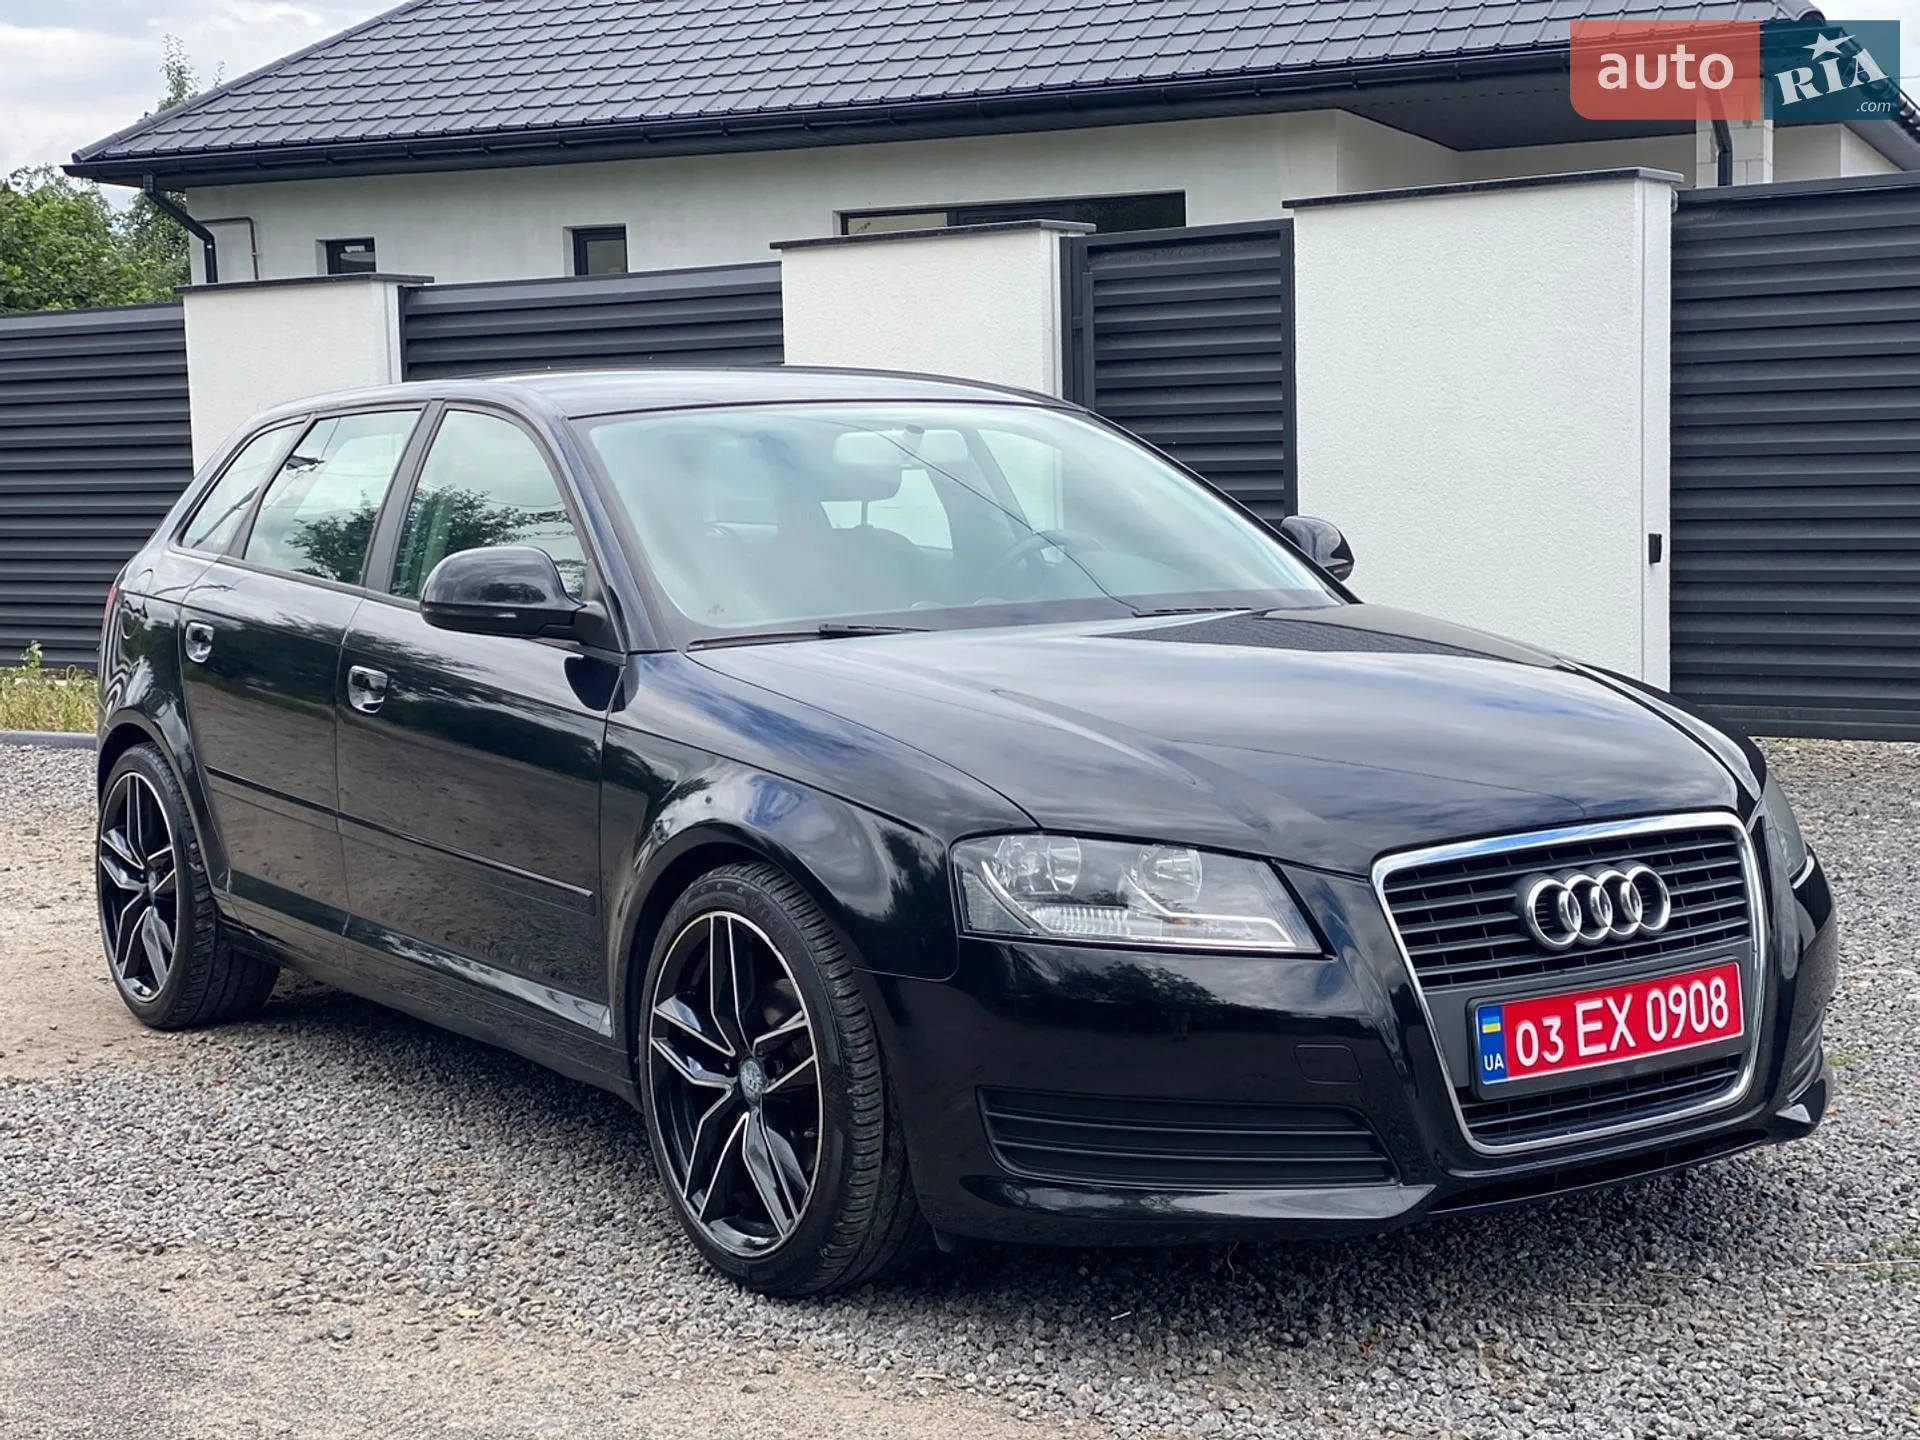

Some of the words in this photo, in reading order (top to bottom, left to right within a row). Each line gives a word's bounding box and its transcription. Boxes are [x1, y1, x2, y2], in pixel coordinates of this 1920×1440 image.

[1515, 1015, 1564, 1067] 03
[1575, 993, 1637, 1057] EX
[1646, 976, 1729, 1042] 0908
[1484, 1053, 1504, 1071] UA
